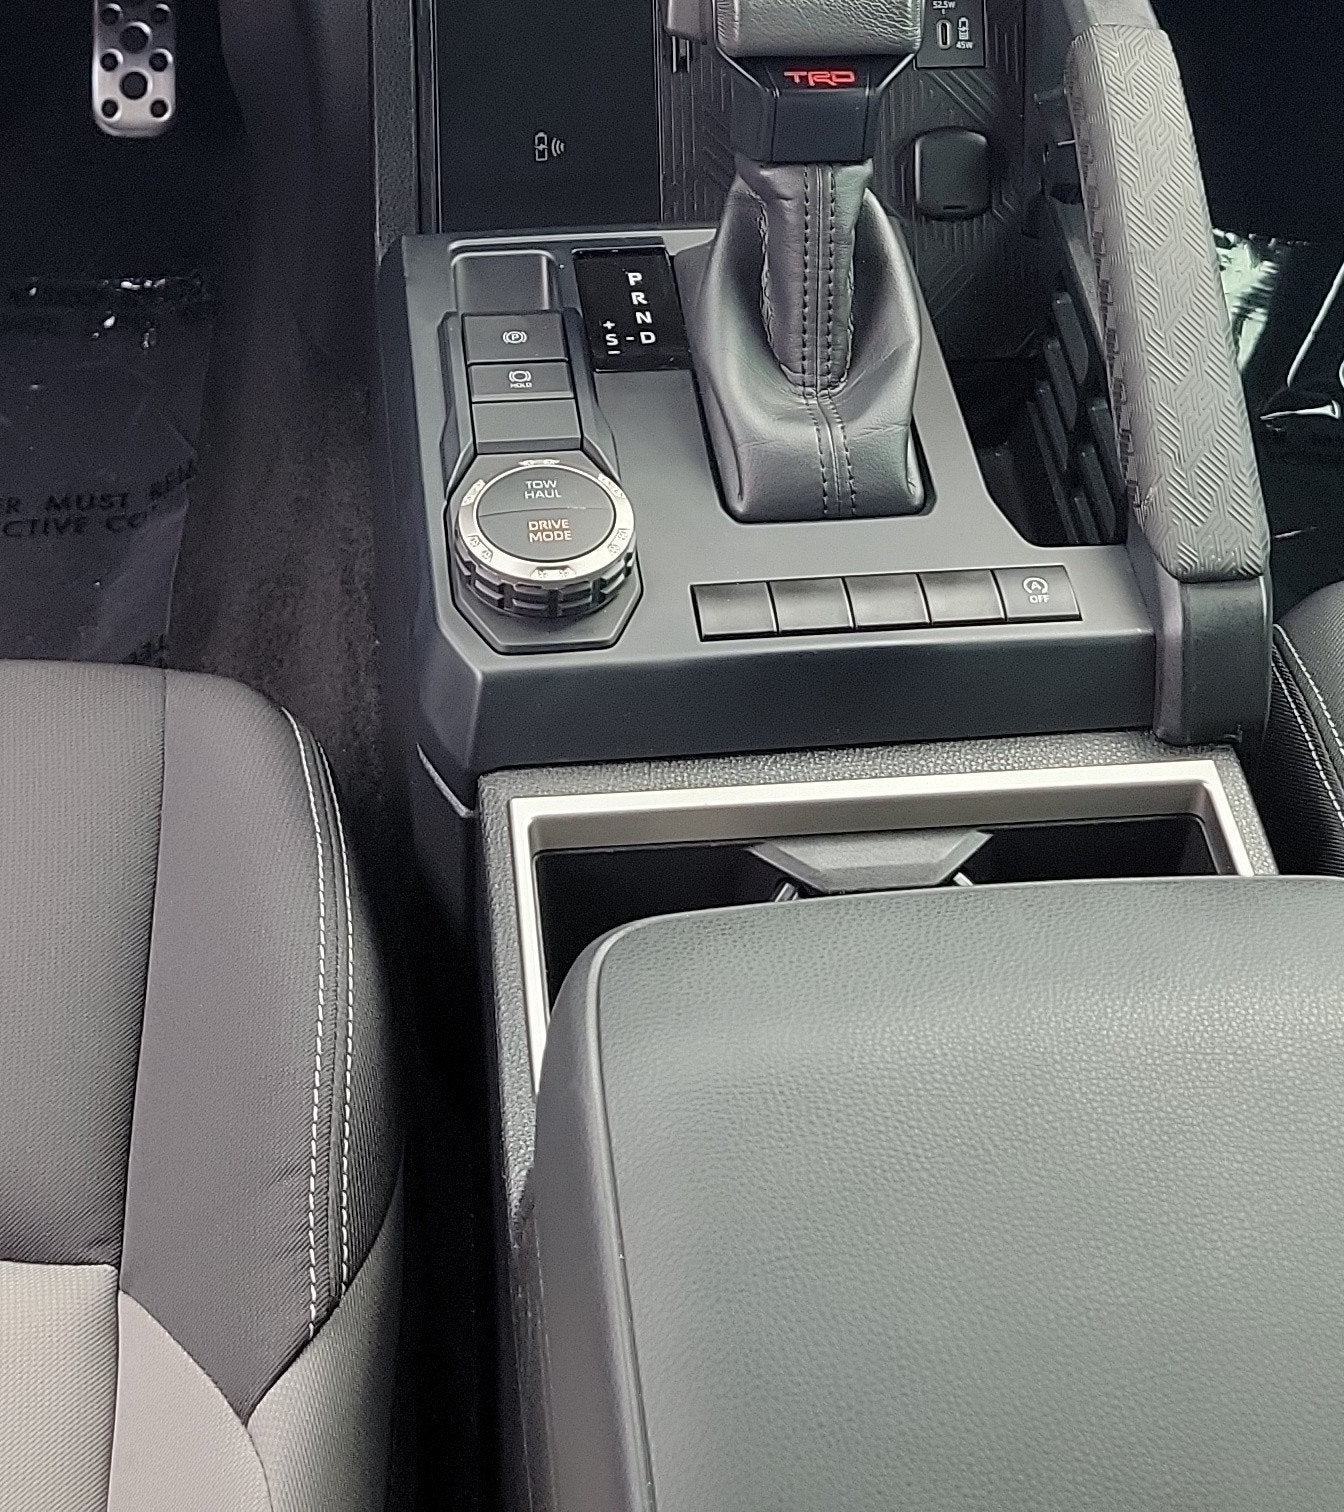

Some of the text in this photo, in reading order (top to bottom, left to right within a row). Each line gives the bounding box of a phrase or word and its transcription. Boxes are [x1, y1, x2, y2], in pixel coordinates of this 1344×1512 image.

[783, 70, 856, 86] TRD
[627, 271, 644, 287] P
[630, 290, 649, 306] R
[635, 310, 654, 325] N
[639, 331, 657, 345] D
[525, 479, 558, 490] TOW
[524, 489, 563, 500] HAUL
[44, 491, 130, 513] MUST
[528, 519, 570, 530] DRIVE
[529, 530, 574, 543] MODE
[1029, 595, 1050, 603] OFF
